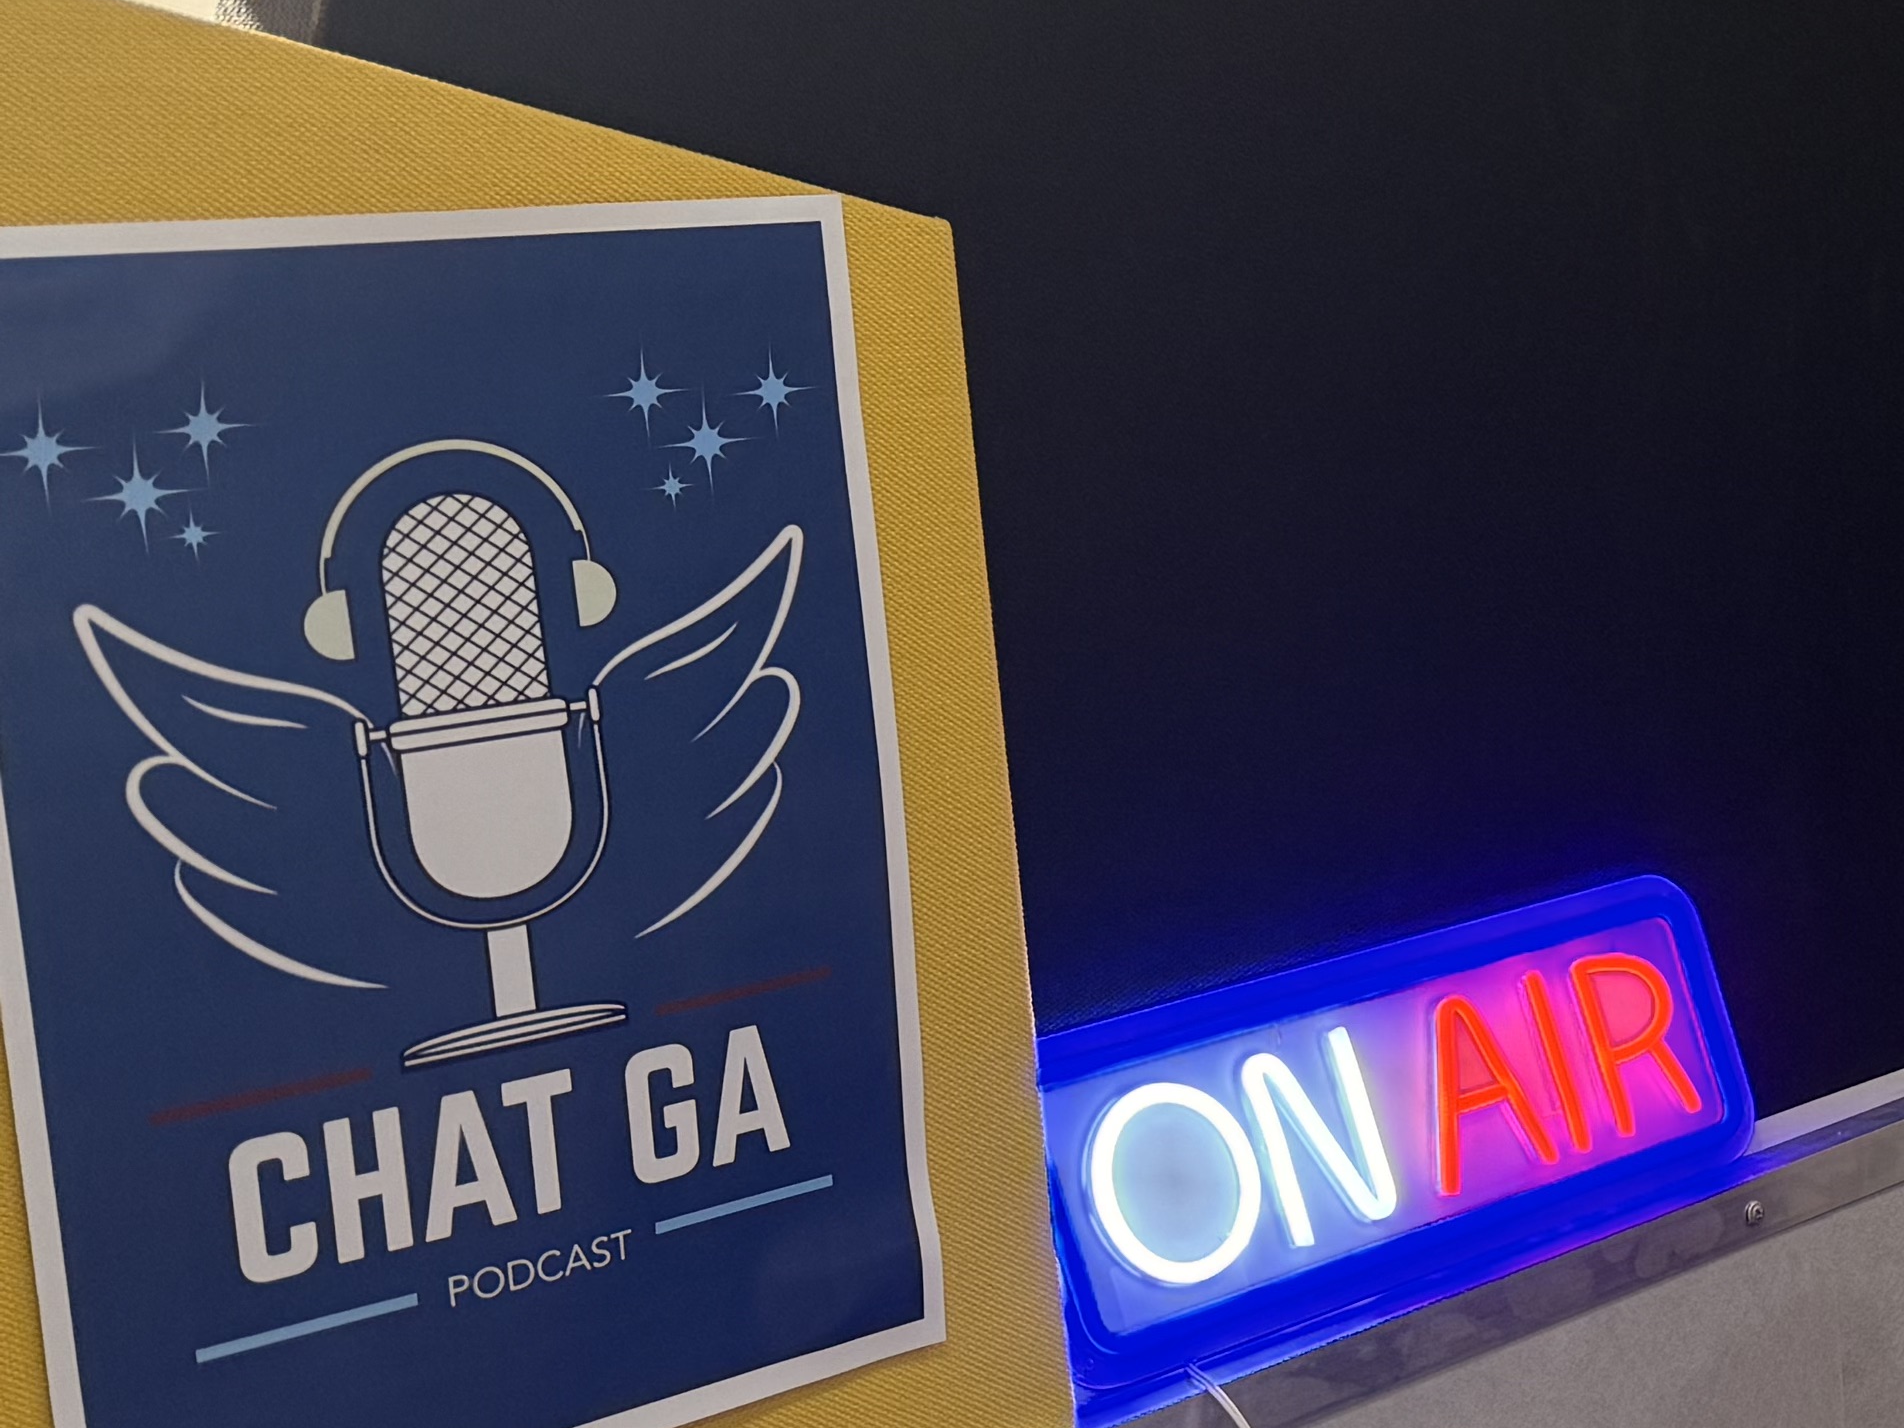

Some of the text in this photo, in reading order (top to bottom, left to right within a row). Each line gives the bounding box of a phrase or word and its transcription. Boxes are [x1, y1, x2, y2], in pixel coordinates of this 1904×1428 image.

[227, 1024, 793, 1287] CHAT GA
[1089, 952, 1703, 1286] ON AIR
[447, 1228, 634, 1309] PODCAST
